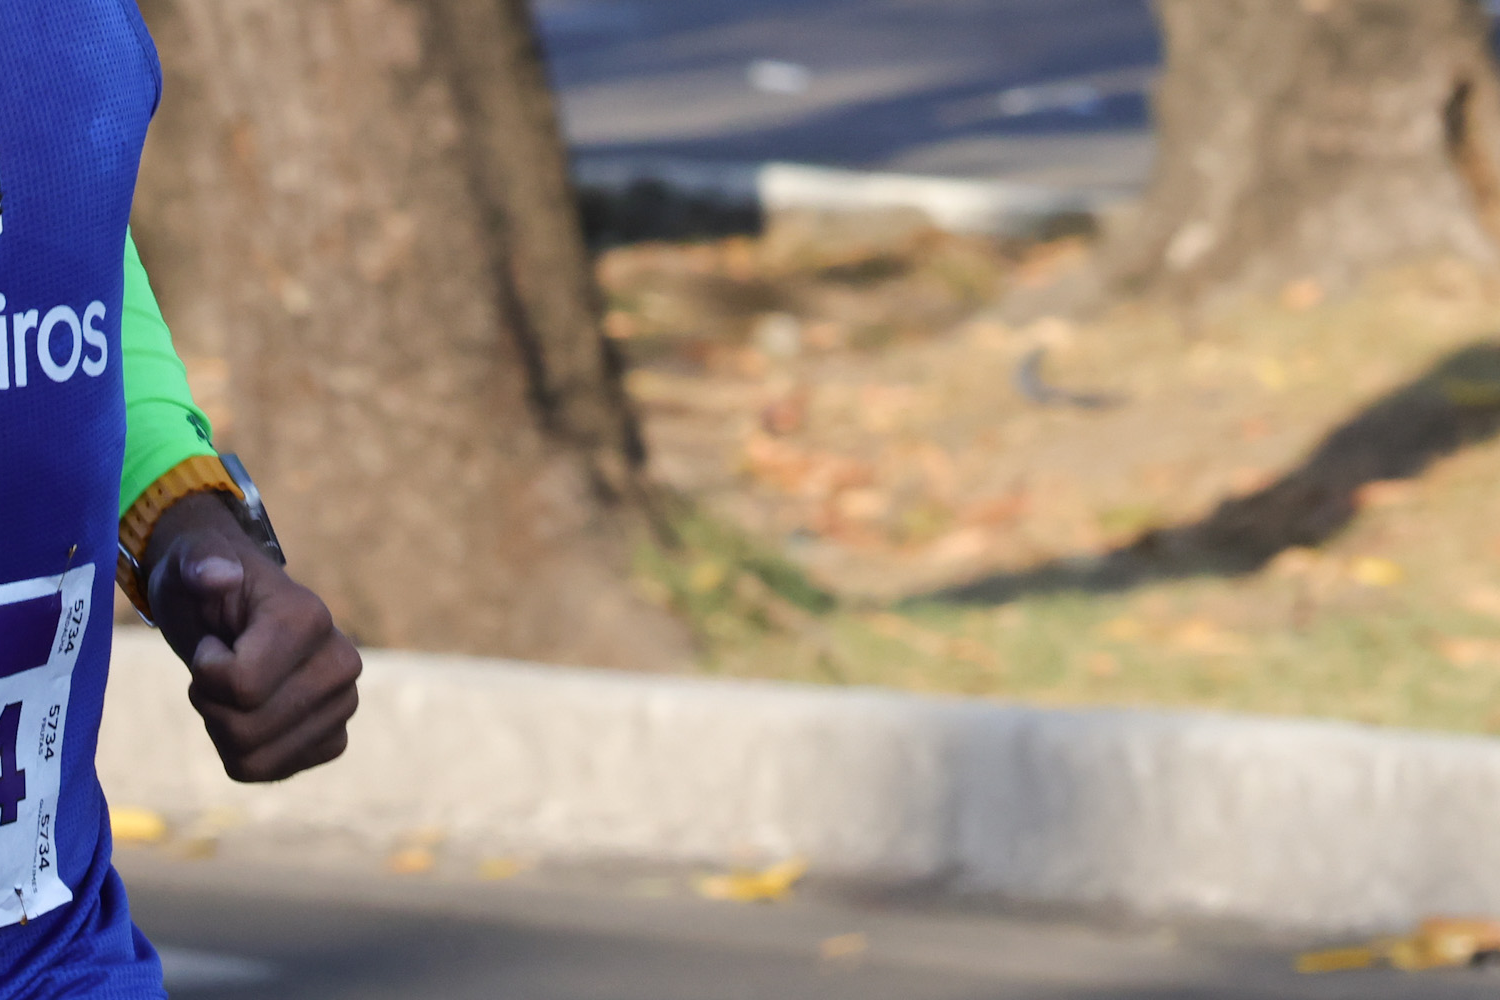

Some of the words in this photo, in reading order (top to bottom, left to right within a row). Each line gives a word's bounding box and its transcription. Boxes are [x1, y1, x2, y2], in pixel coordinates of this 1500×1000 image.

[64, 598, 84, 656] 5734
[44, 704, 60, 762] 5734
[39, 814, 50, 872] 5734
